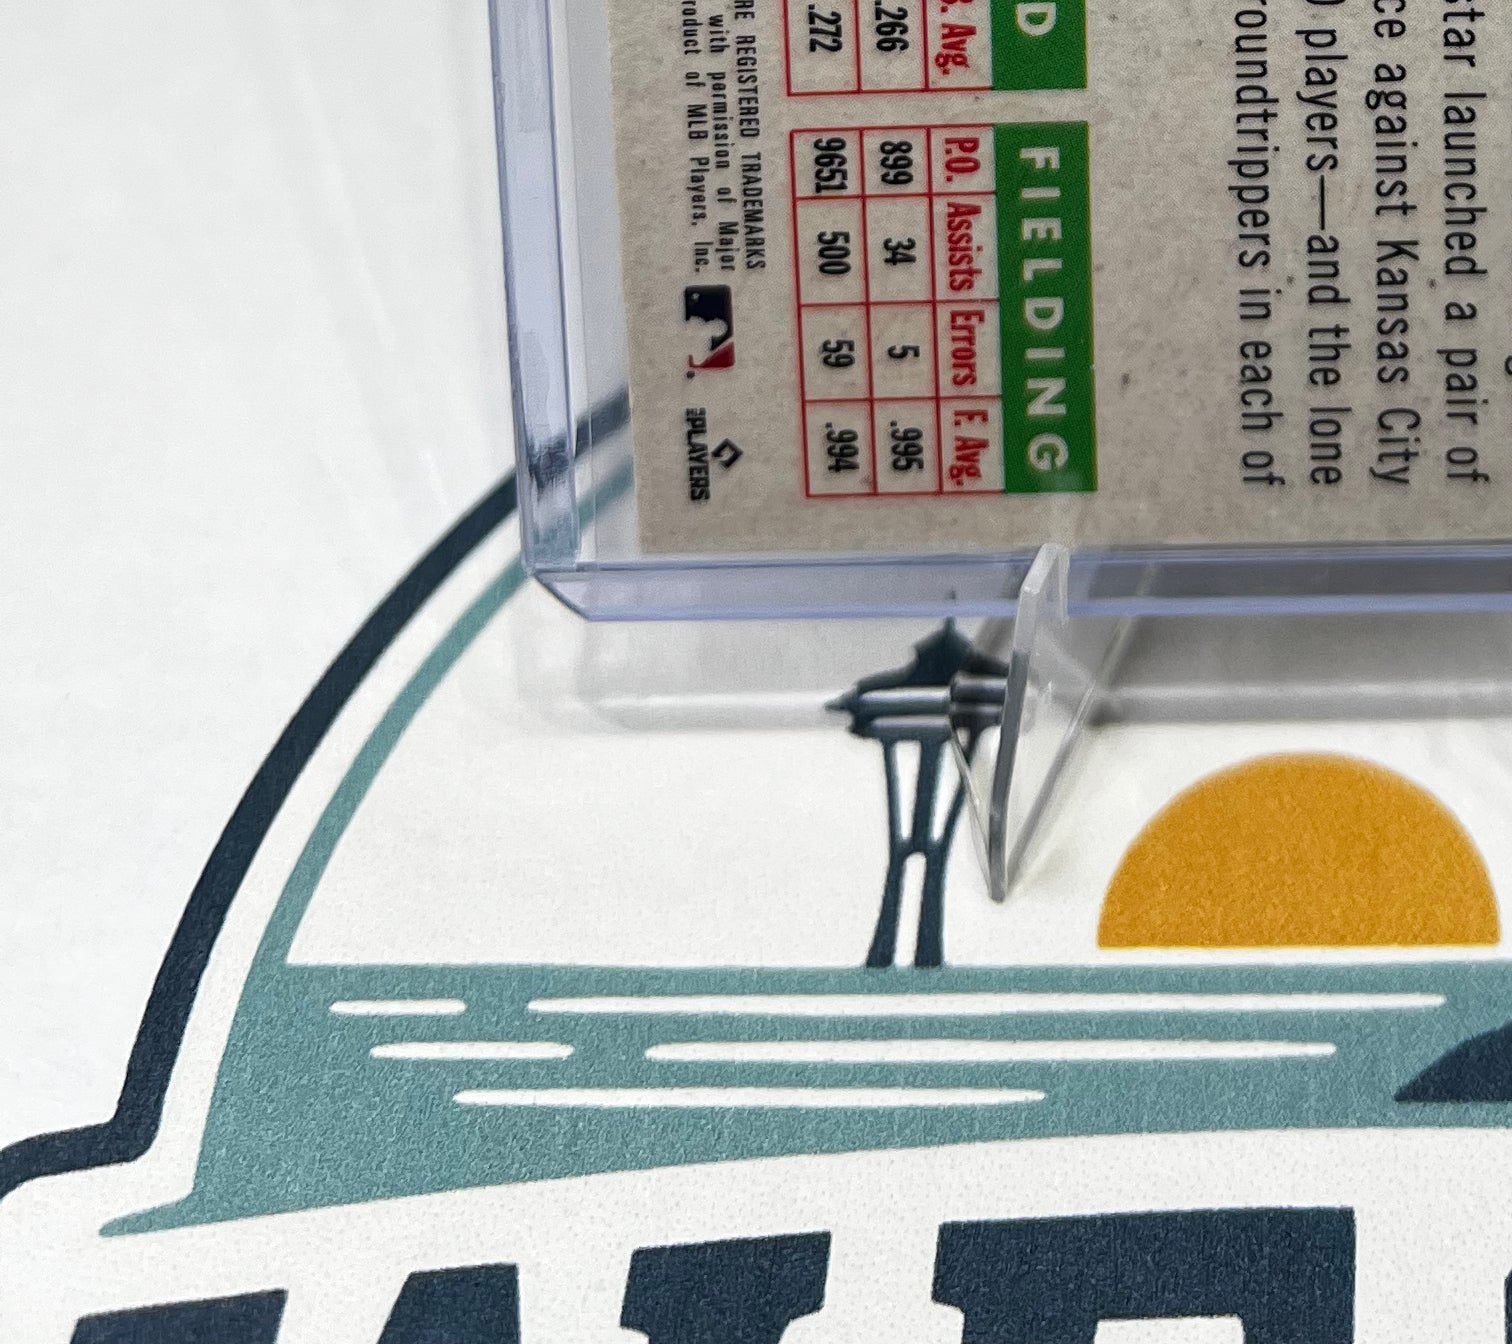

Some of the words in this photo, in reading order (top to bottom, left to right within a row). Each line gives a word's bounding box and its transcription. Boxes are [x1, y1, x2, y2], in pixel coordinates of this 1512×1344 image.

[806, 4, 843, 53] .272
[873, 0, 910, 53] .266
[933, 22, 977, 76] Avg.
[734, 35, 760, 138] REGISTERED
[812, 137, 848, 194] 9651
[878, 141, 914, 186] 899
[943, 137, 981, 183] P.O.
[1441, 92, 1488, 277] launched
[740, 152, 766, 270] TRADEMARKS
[816, 231, 852, 276] 500
[881, 237, 917, 266] 34
[945, 202, 982, 292] Assists
[1018, 145, 1069, 473] FIELDING
[1443, 301, 1478, 322] a
[820, 339, 856, 369] 59
[886, 345, 920, 361] 5
[948, 309, 985, 388] Errors
[1307, 323, 1352, 388] the
[1435, 348, 1489, 426] pair
[952, 409, 989, 427] F.
[683, 416, 712, 503] PLAYERS
[824, 422, 860, 474] .994
[889, 421, 924, 473] .995
[947, 436, 990, 487] Avg.
[1307, 407, 1353, 486] lone
[1444, 446, 1490, 484] of
